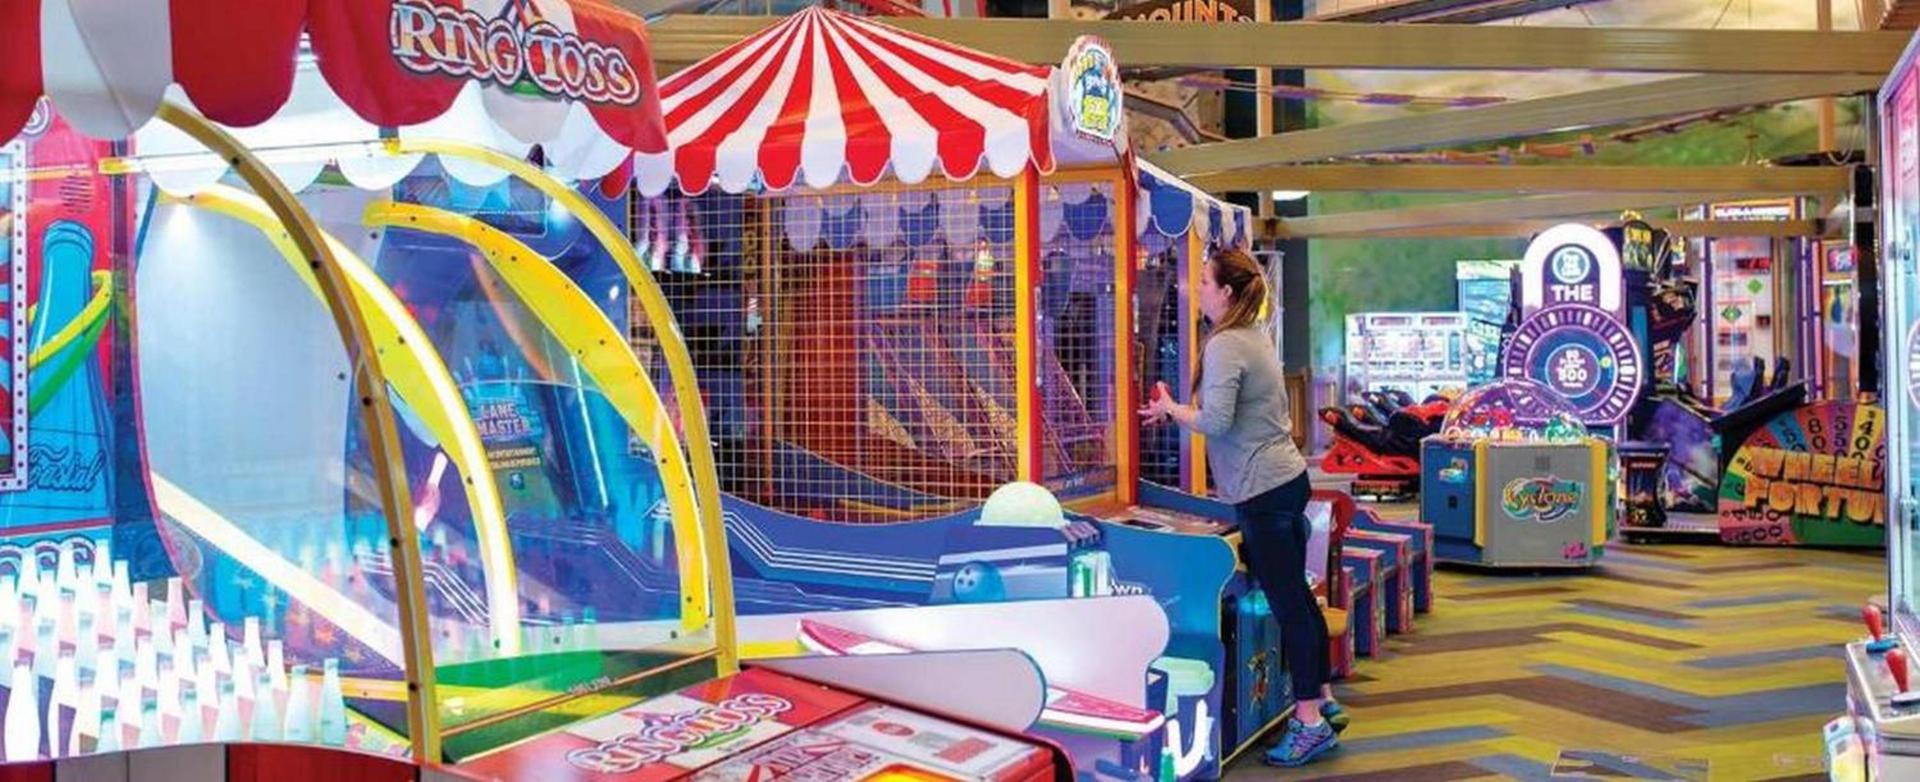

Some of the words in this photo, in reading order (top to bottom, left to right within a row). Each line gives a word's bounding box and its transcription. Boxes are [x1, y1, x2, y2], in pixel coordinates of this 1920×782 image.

[390, 1, 521, 82] RING
[523, 26, 638, 101] TOSS
[1551, 284, 1594, 302] THE
[1749, 446, 1883, 490] WHEEL
[565, 722, 706, 774] RING
